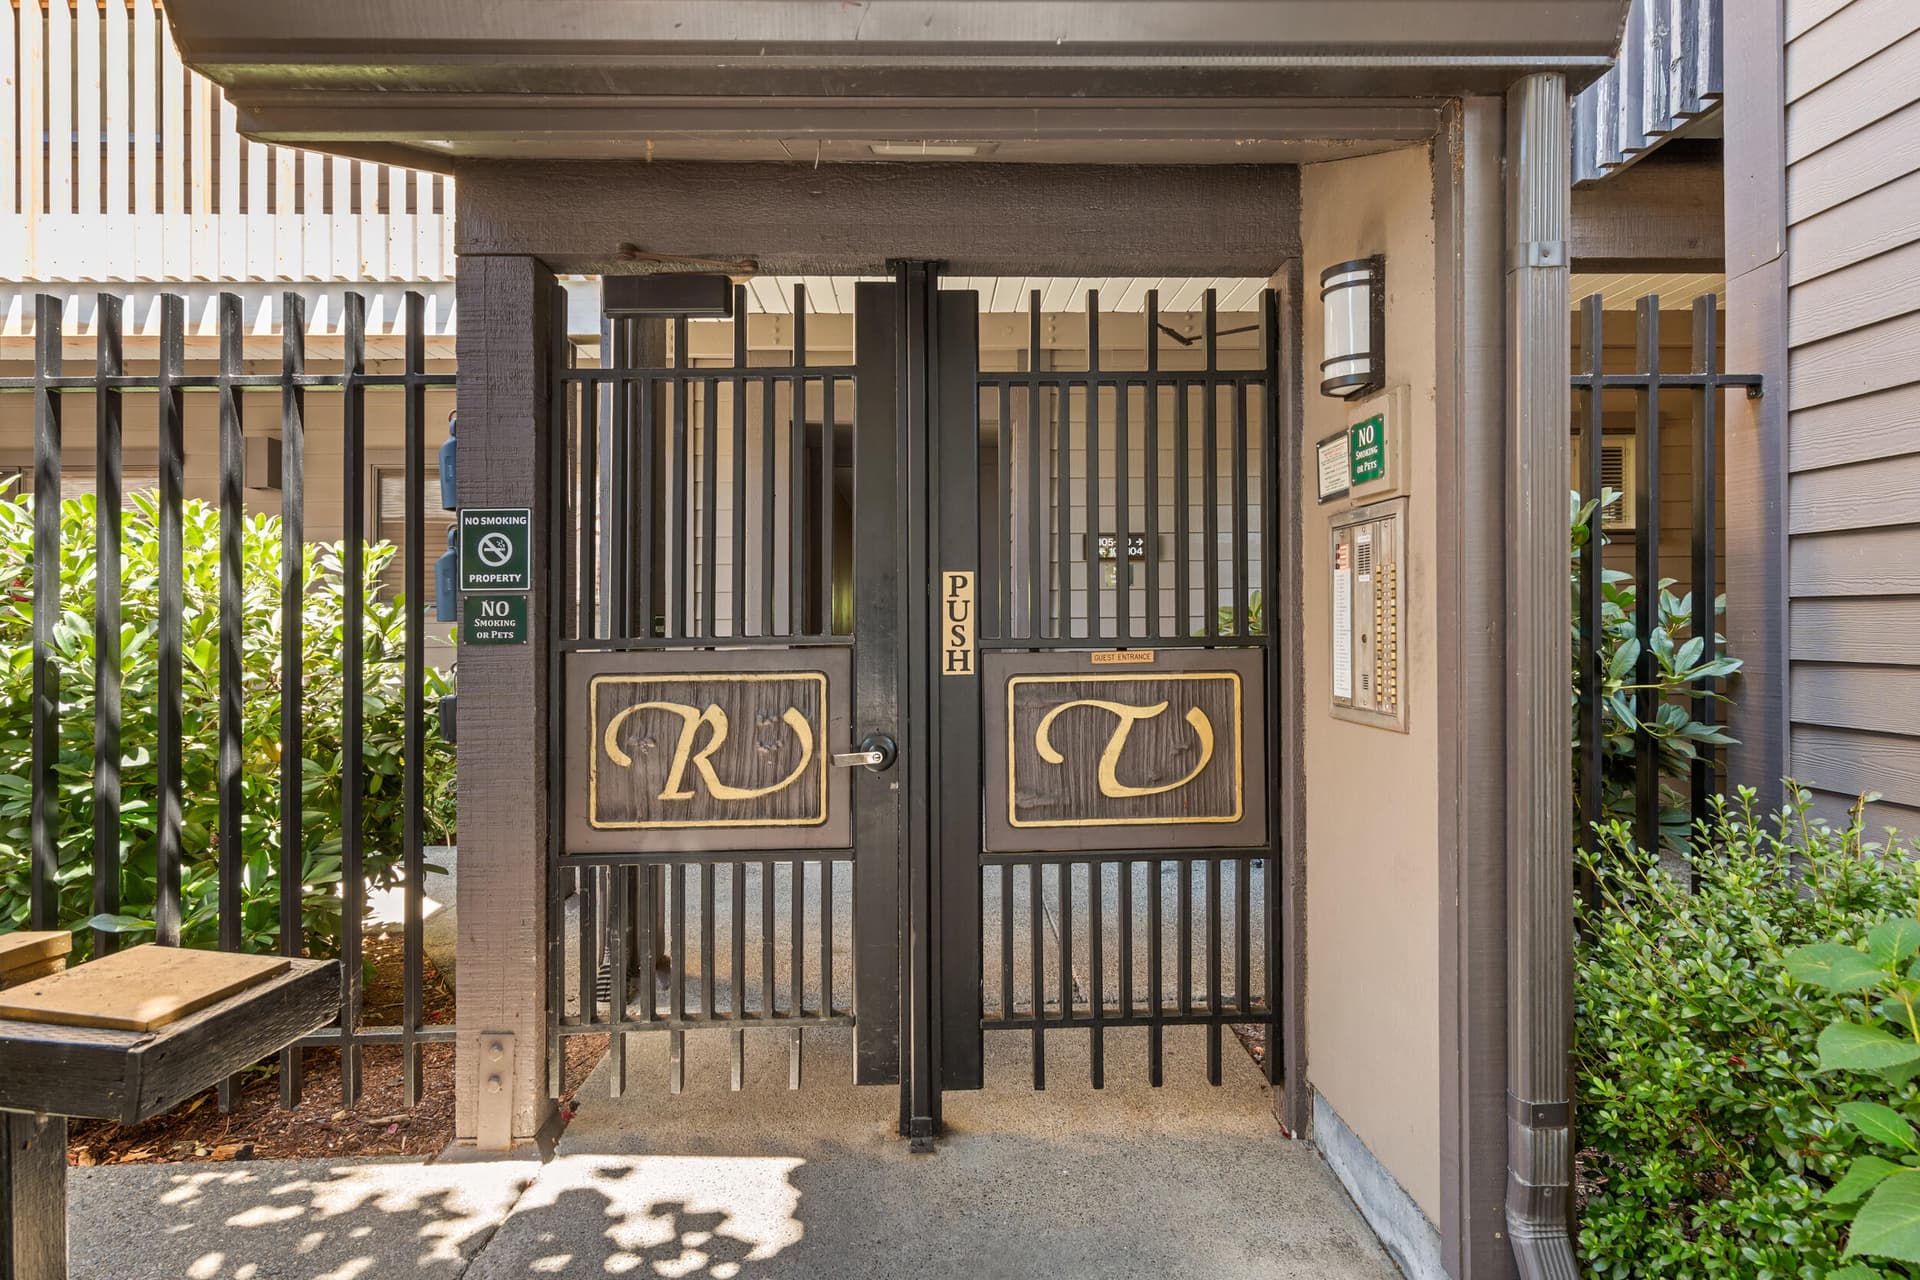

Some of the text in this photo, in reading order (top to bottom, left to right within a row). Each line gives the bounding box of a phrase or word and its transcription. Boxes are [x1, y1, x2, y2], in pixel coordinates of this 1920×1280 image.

[1358, 425, 1374, 448] NO
[464, 516, 527, 526] NO SMOKING
[469, 574, 521, 583] PROPERTY
[480, 600, 510, 617] NO
[945, 575, 971, 672] PUSH
[1094, 653, 1151, 662] GUEST ENTRANCE
